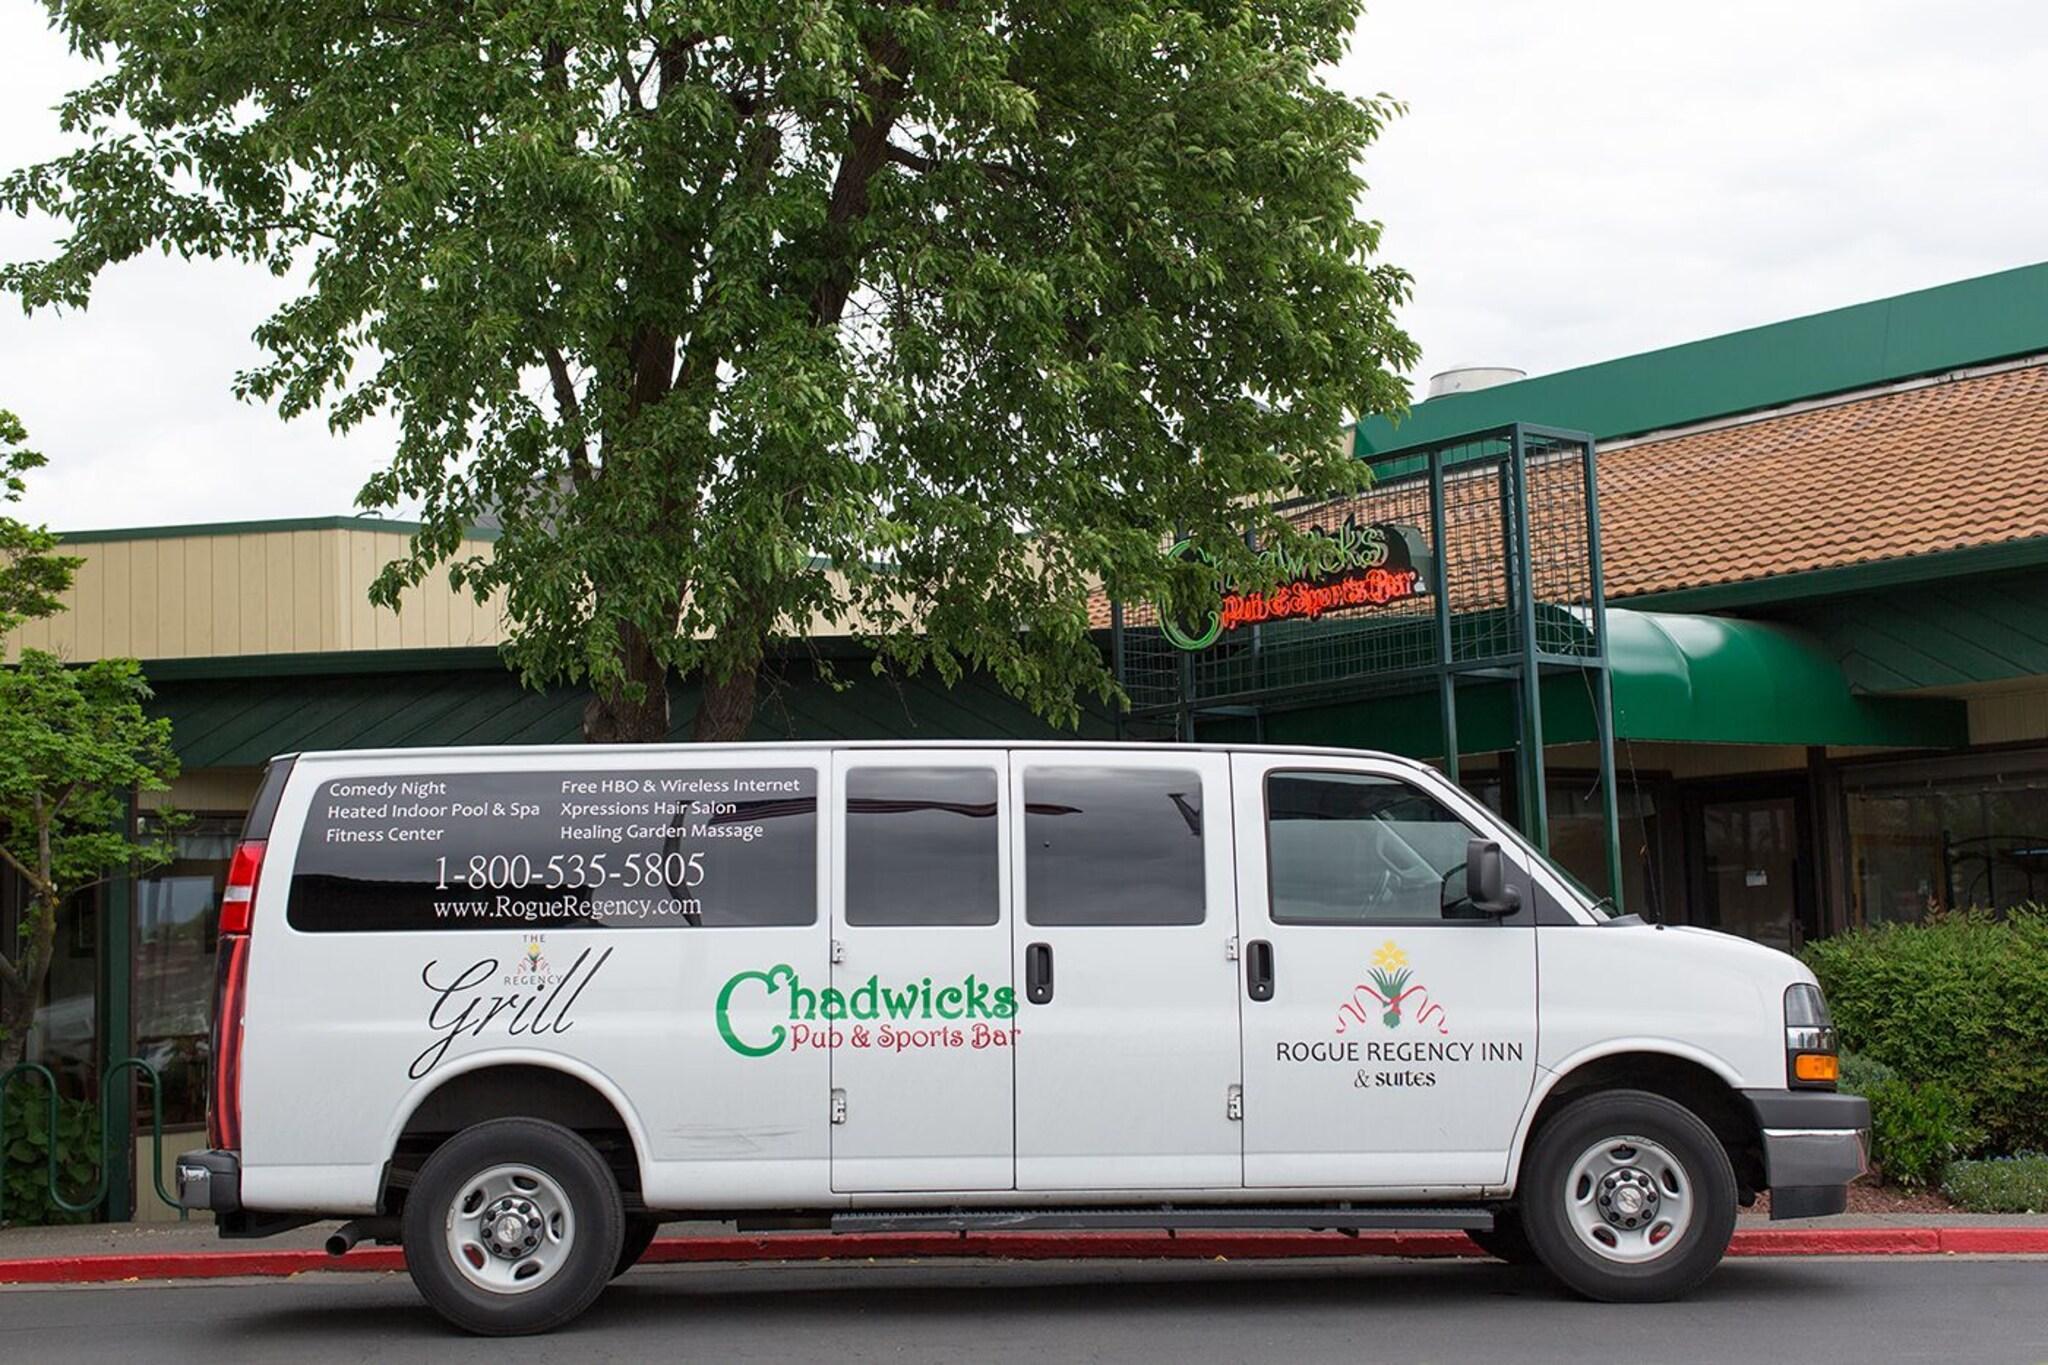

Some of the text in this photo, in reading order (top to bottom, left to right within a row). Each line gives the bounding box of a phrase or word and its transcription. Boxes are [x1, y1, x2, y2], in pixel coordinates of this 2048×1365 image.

[1366, 569, 1417, 603] Bar
[329, 781, 447, 799] Comedy Night
[561, 779, 800, 794] Free HBO & Wireless Internet
[328, 802, 540, 820] Heated Indoor Pool & Spa
[560, 800, 737, 819] Xpressions Hair Salon
[326, 827, 444, 843] Fitness Center
[560, 823, 764, 844] Healing Garden Massage
[434, 852, 705, 890] 1-800-535-5805
[433, 895, 702, 921] www.RogueRegency.com
[522, 934, 546, 943] THE
[503, 975, 564, 986] REGENCY
[408, 946, 614, 1080] Grill
[715, 963, 1019, 1058] Chadwicks
[790, 1023, 1022, 1052] Pub & Sports Bar
[1276, 1042, 1523, 1062] ROGUE REGENCY INN
[1354, 1069, 1436, 1088] & suites
